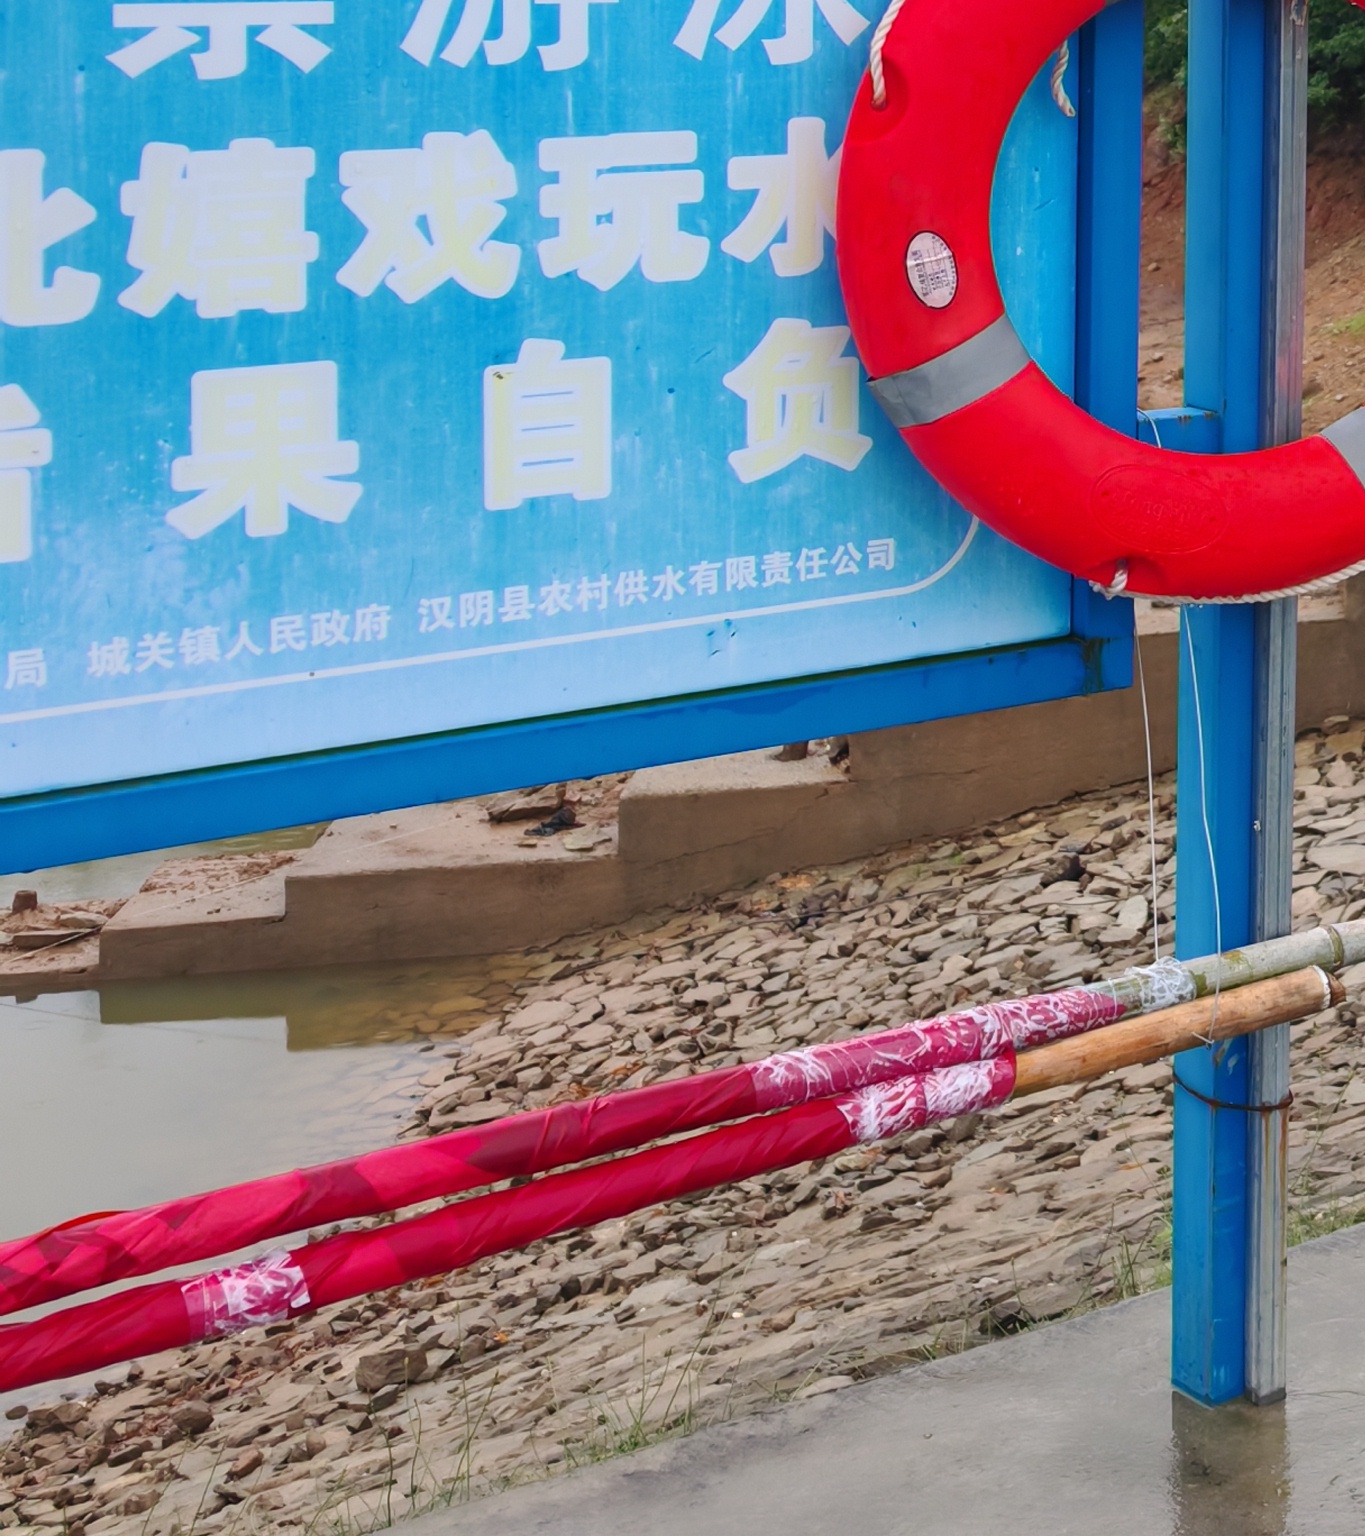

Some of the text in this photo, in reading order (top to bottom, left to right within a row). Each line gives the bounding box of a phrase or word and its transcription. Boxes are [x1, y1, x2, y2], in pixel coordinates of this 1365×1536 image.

[0, 316, 874, 563] 果自负
[3, 536, 897, 690] 局 城关镇人民政府 汉阴县农村供水有限责任公司
